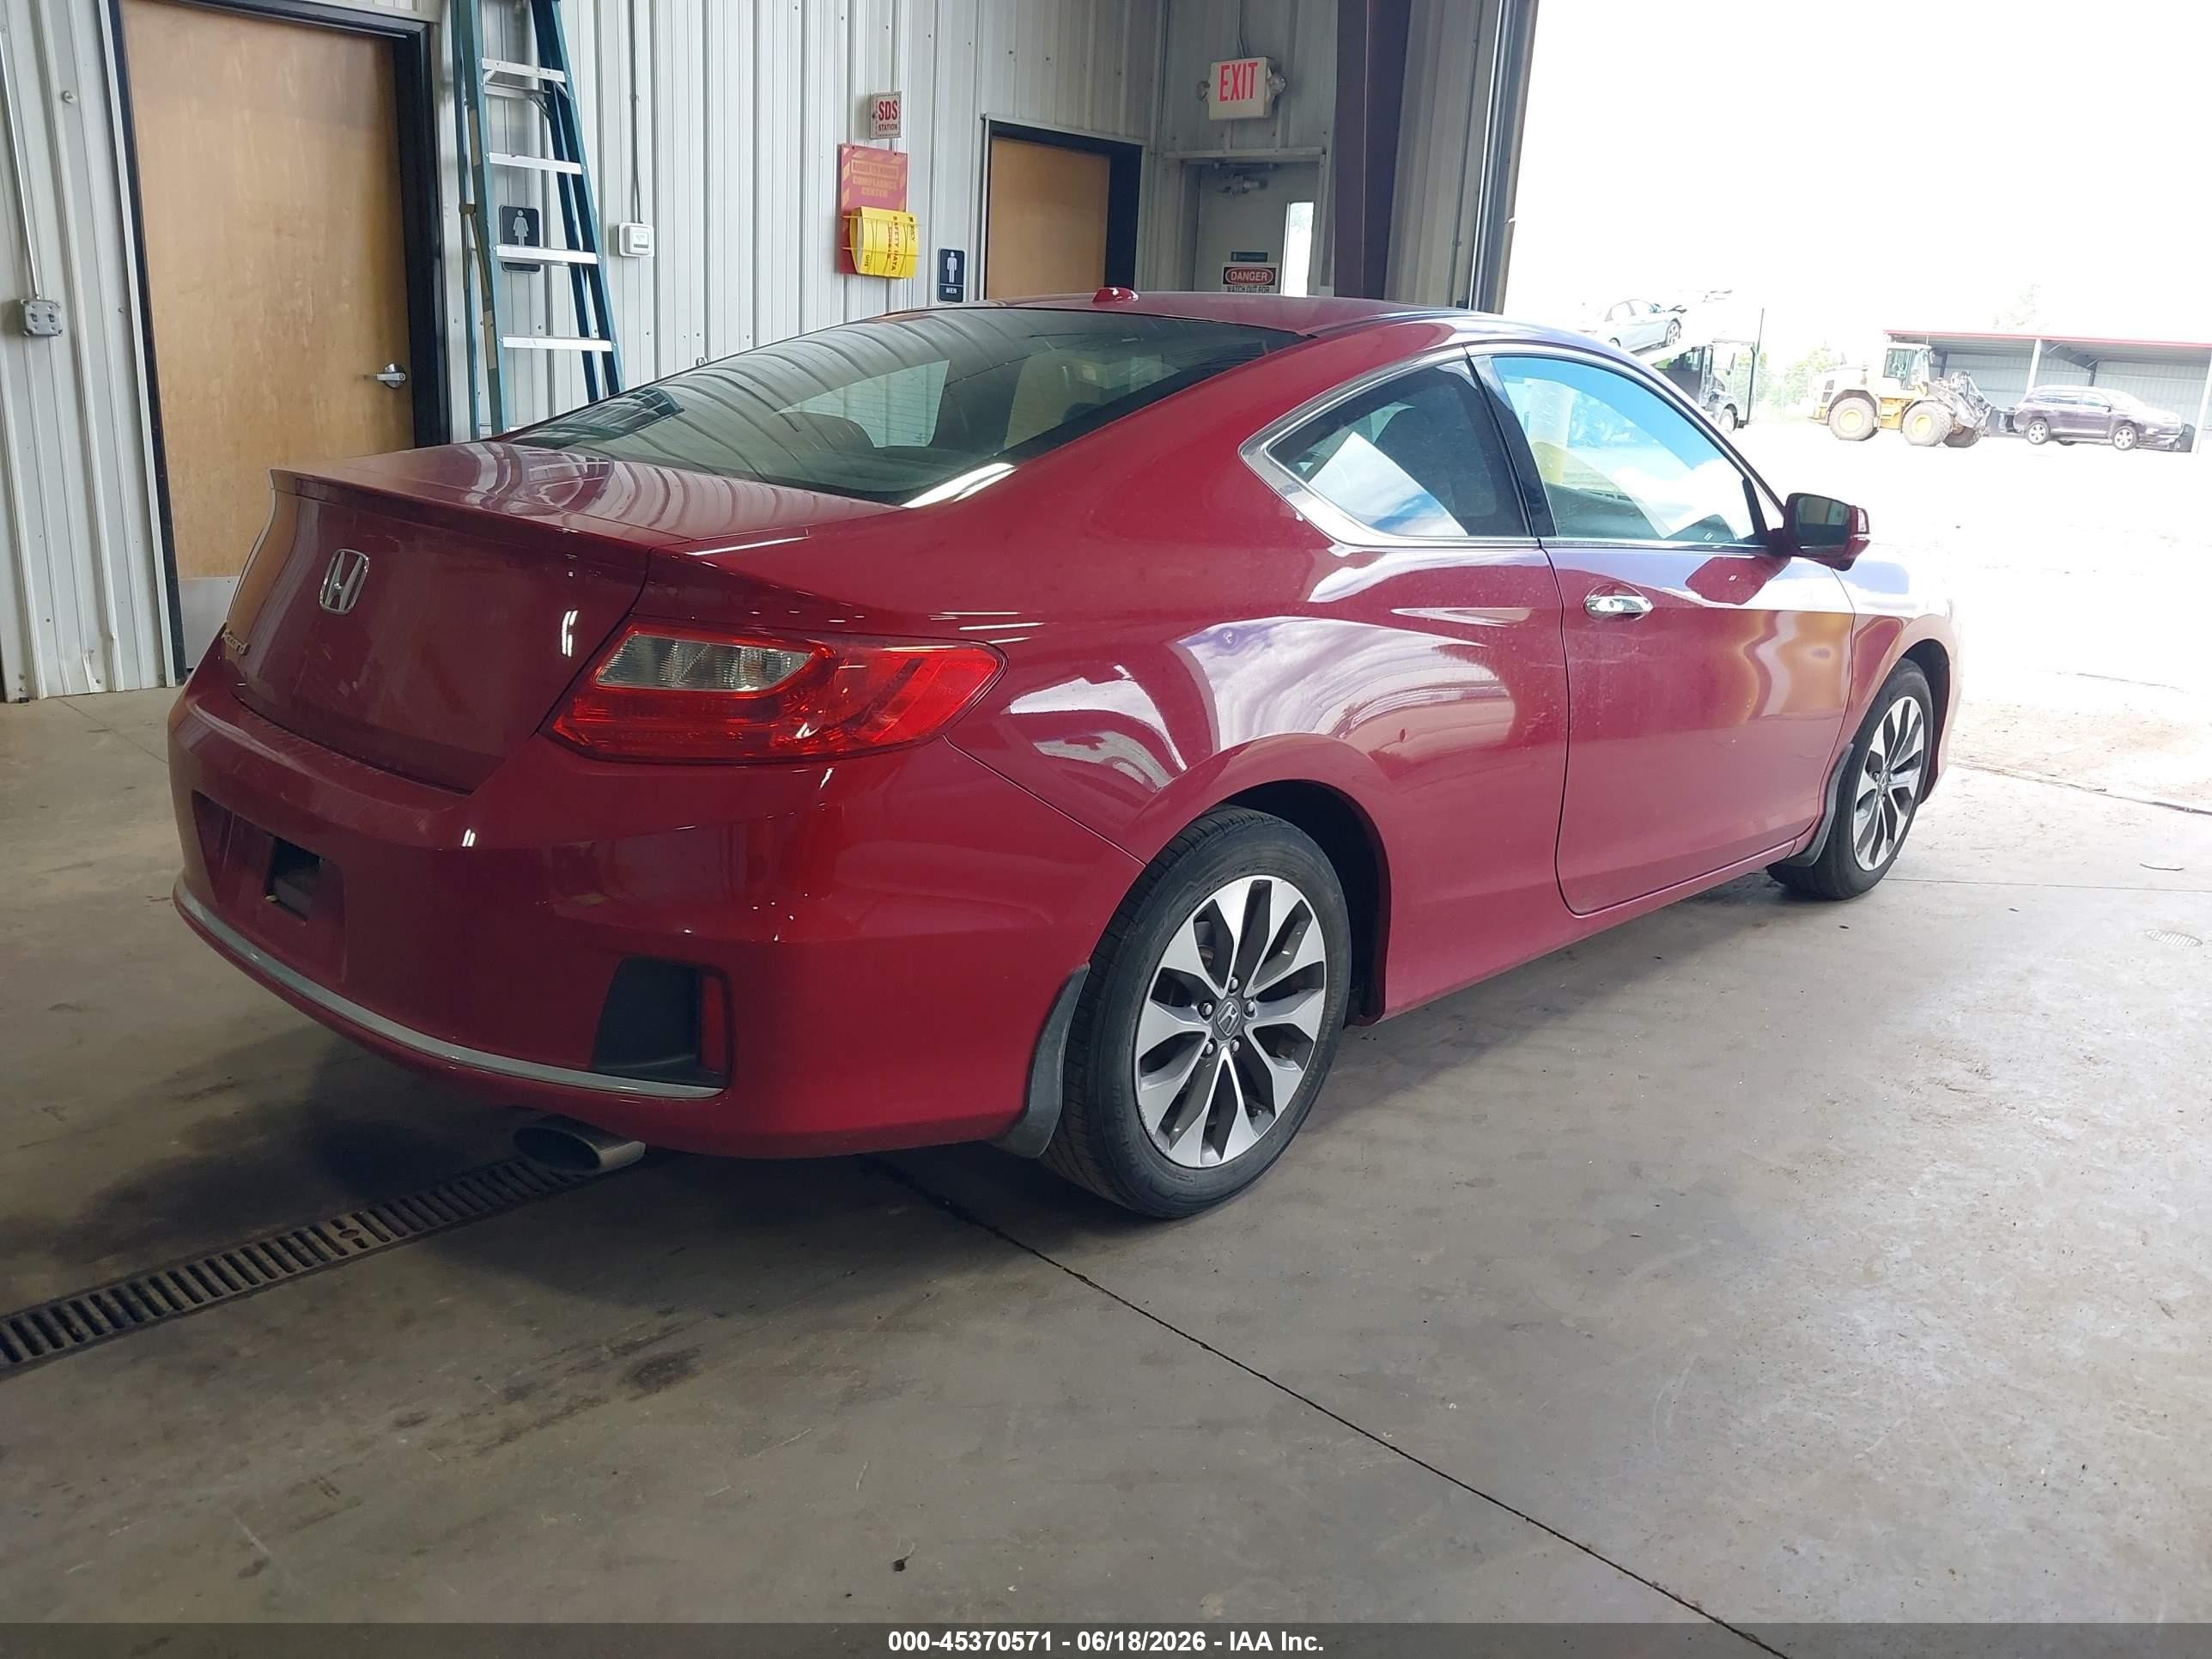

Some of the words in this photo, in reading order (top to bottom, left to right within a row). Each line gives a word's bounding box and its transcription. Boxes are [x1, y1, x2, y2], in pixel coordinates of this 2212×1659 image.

[1219, 62, 1258, 101] EXIT
[878, 100, 897, 121] SDS
[878, 123, 898, 131] STATION
[861, 186, 888, 198] CENTER
[1231, 270, 1267, 282] DANGER
